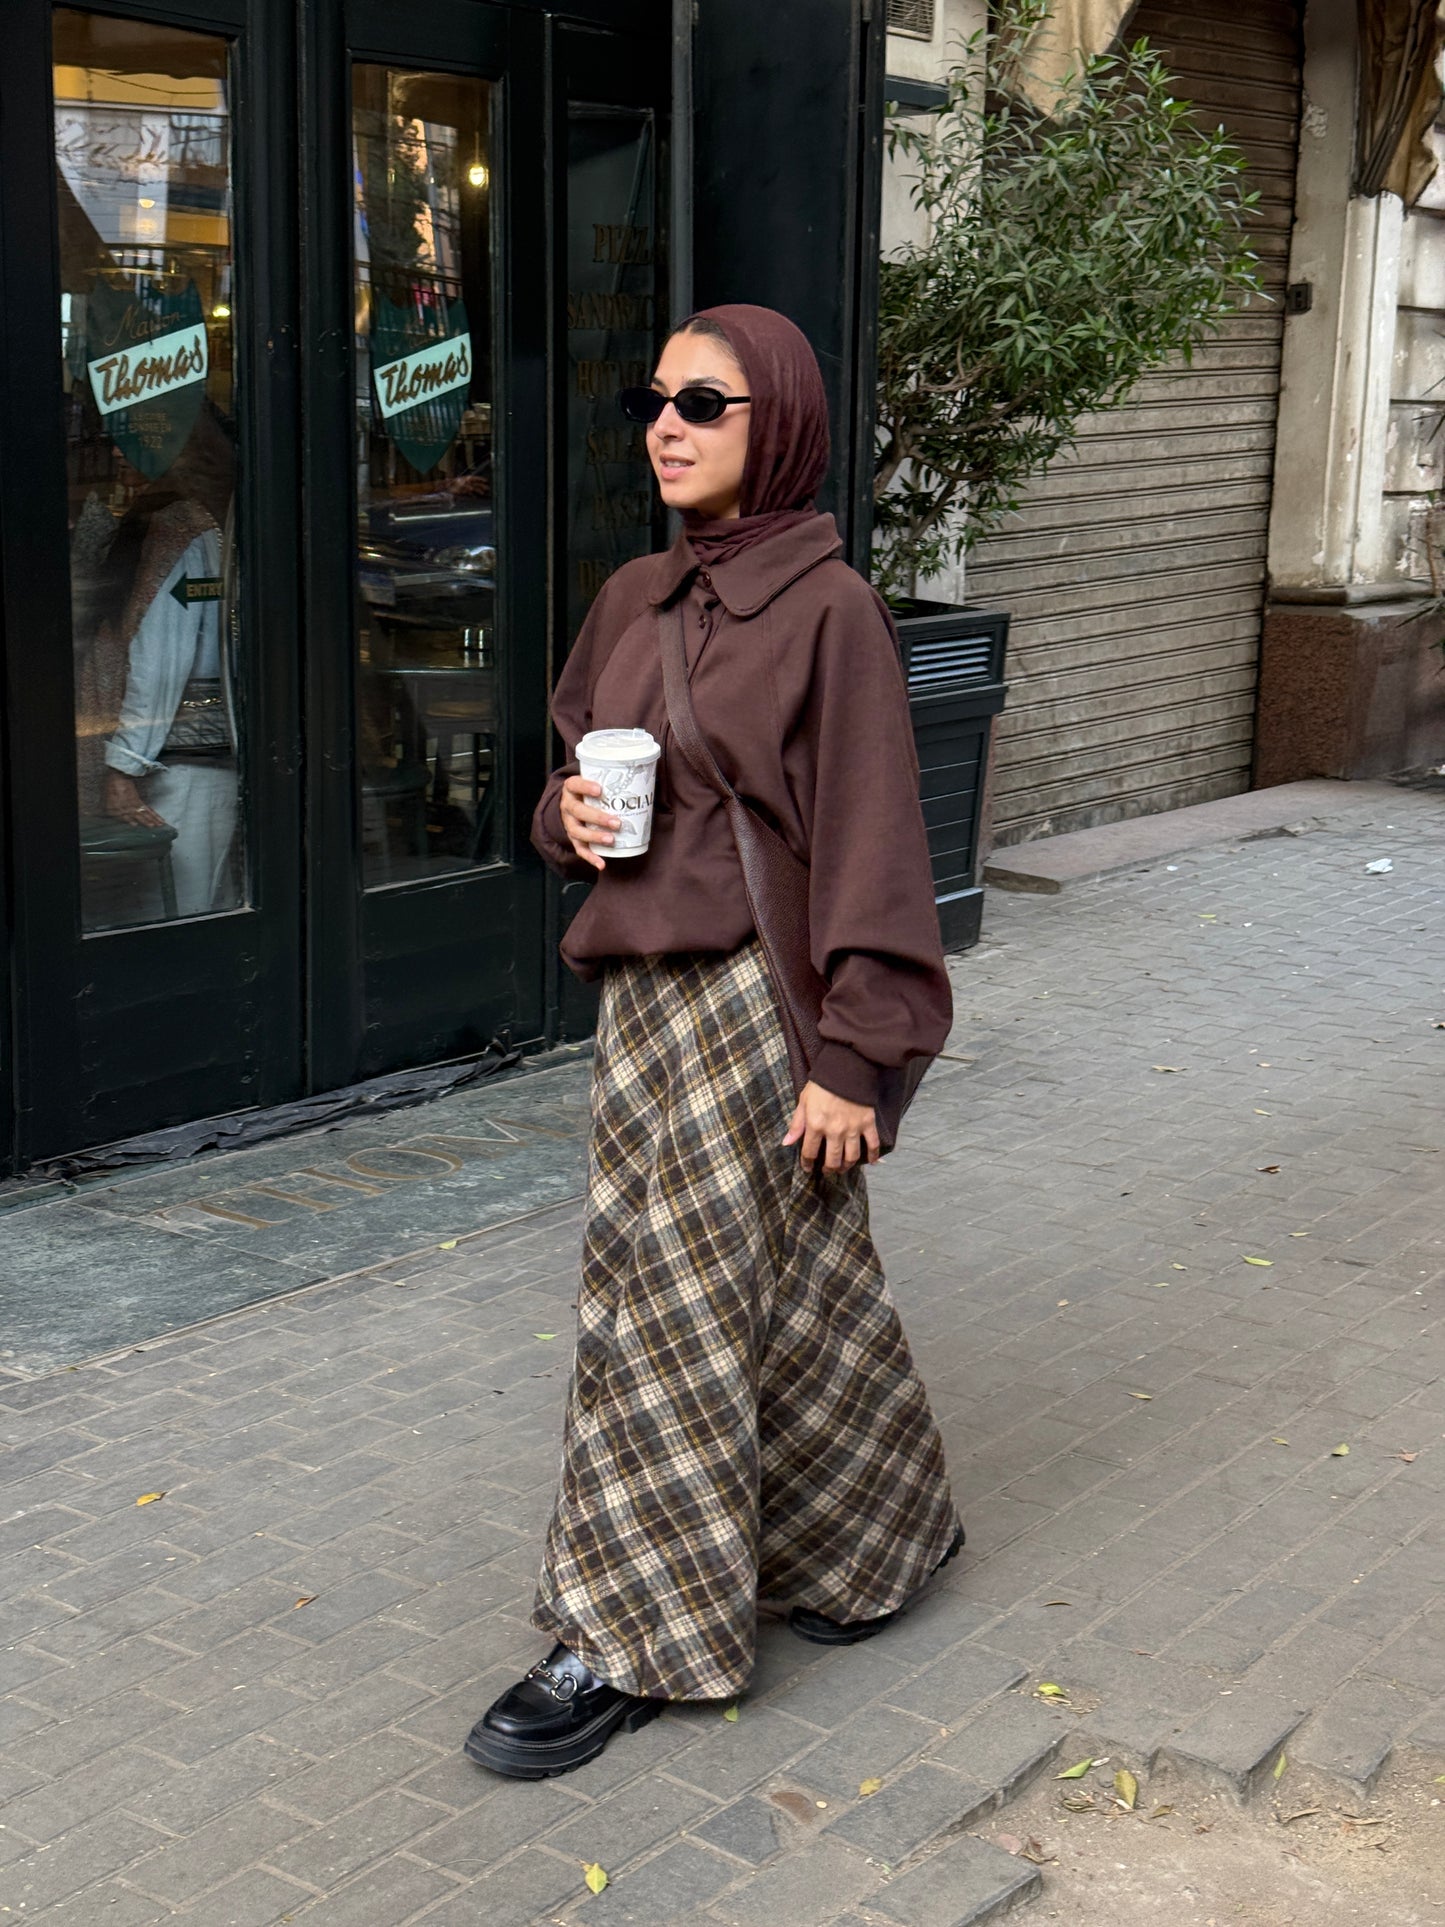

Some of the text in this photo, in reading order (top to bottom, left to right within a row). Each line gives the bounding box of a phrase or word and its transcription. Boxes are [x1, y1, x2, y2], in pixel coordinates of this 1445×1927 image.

[95, 334, 204, 406] Thomas
[380, 341, 470, 408] Thomas
[186, 582, 224, 597] ENTRY
